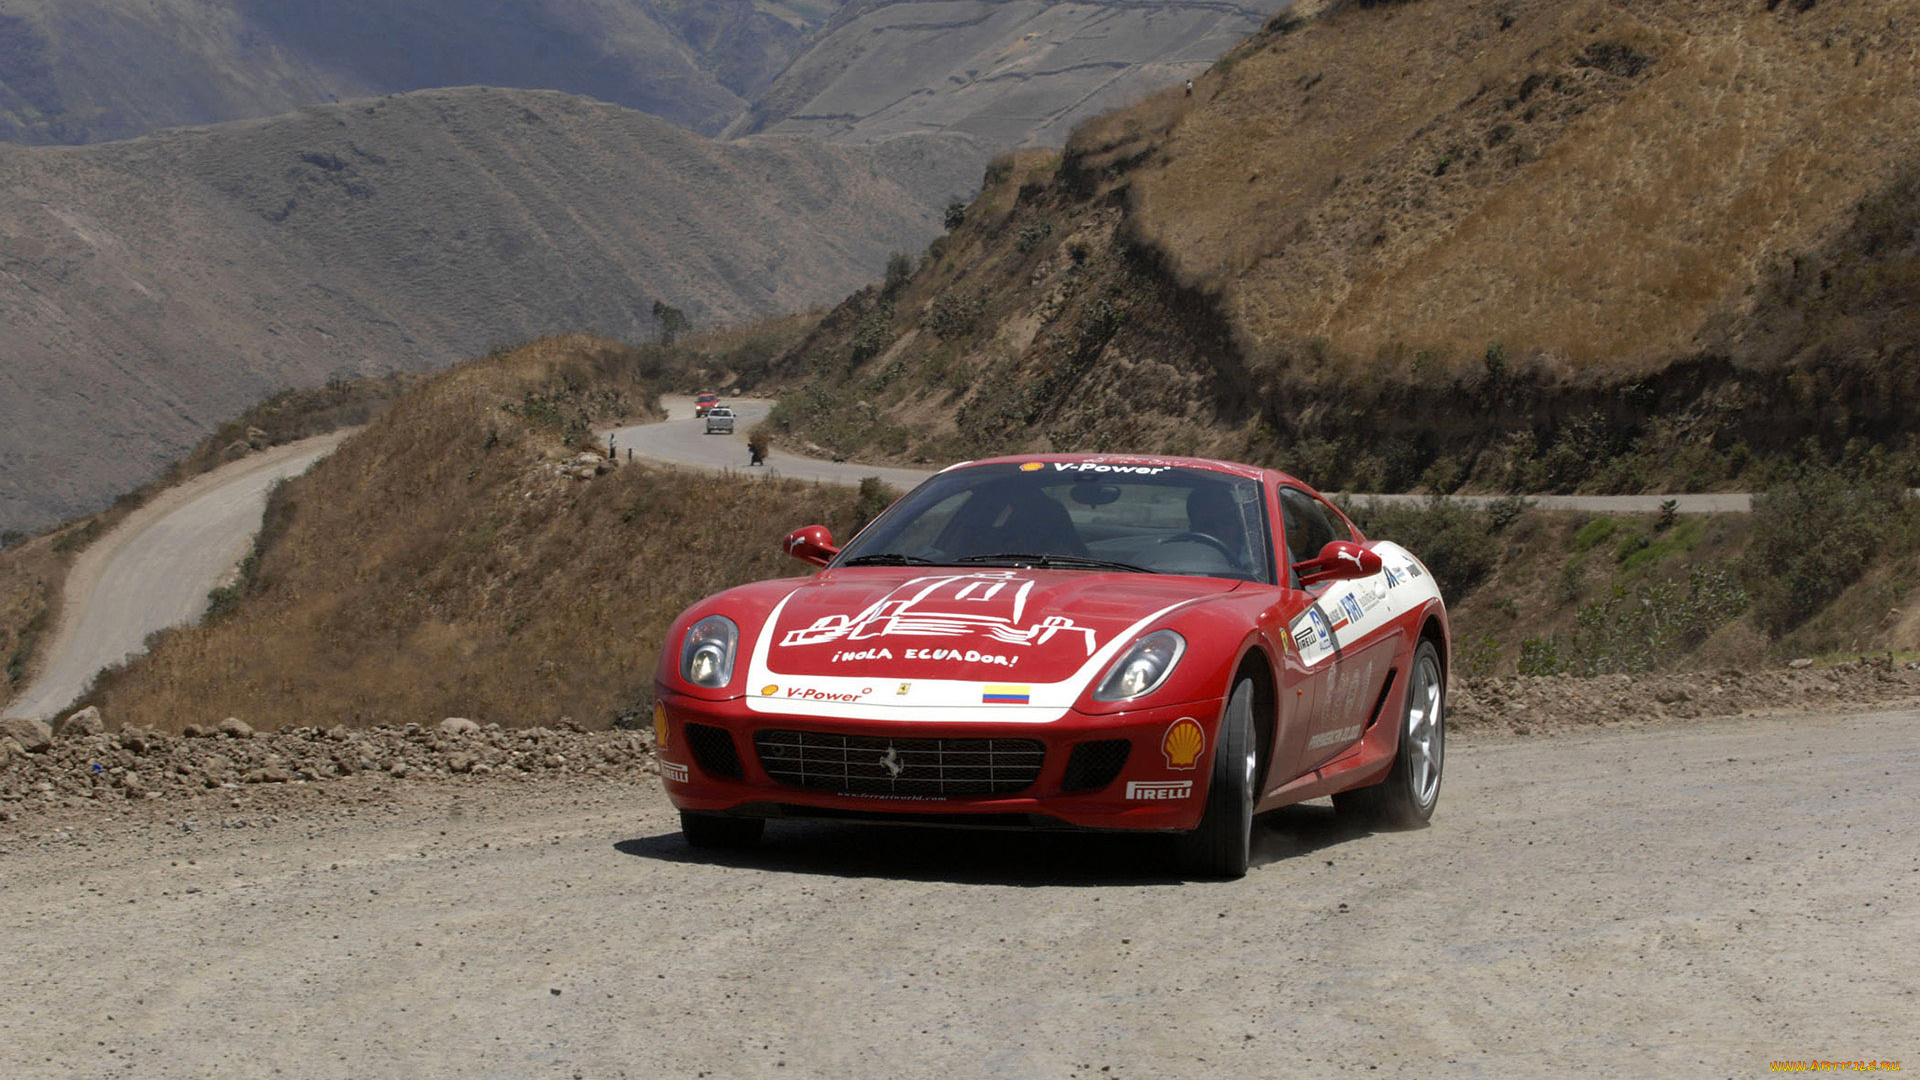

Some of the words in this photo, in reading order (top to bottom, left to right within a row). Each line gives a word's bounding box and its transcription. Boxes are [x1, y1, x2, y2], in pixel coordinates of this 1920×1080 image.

[1054, 462, 1165, 475] V-Power
[904, 648, 1020, 668] ECUADOR!
[786, 687, 863, 702] V-Power
[1125, 780, 1193, 800] PIRELLI
